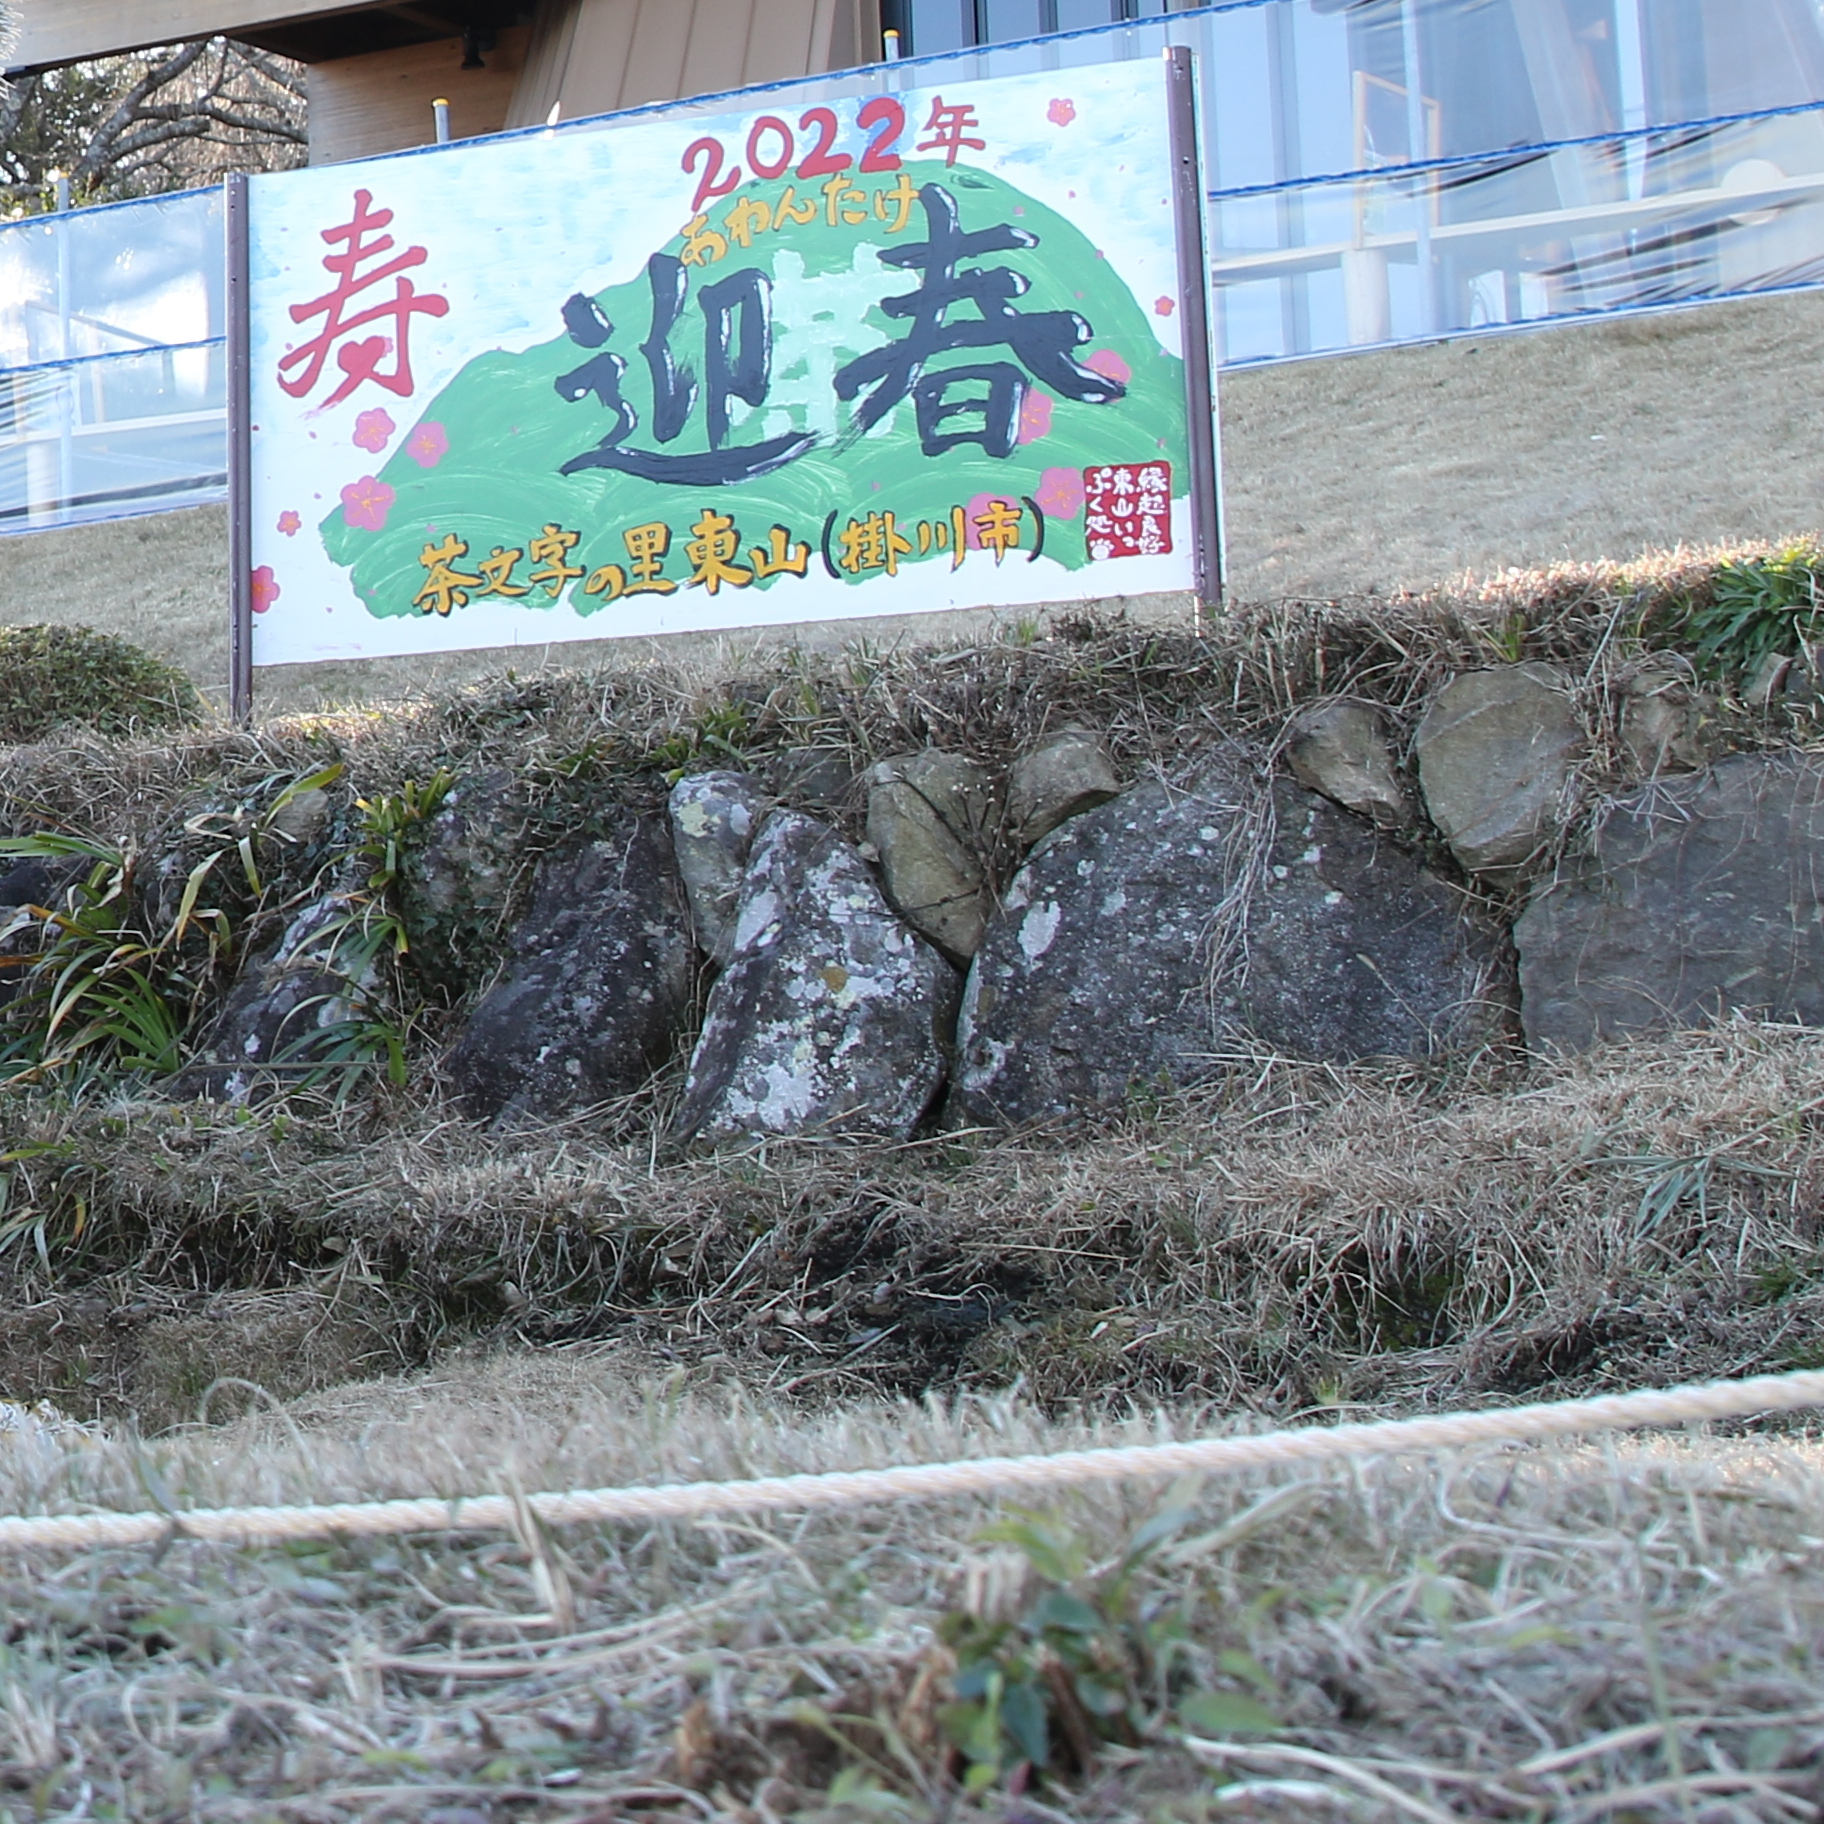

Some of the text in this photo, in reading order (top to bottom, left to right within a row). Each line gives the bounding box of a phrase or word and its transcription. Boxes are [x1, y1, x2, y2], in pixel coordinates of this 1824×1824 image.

[679, 173, 920, 267] あわんたけ
[681, 95, 985, 212] 2022年
[277, 188, 450, 412] 寿
[554, 183, 1125, 486] 迎春
